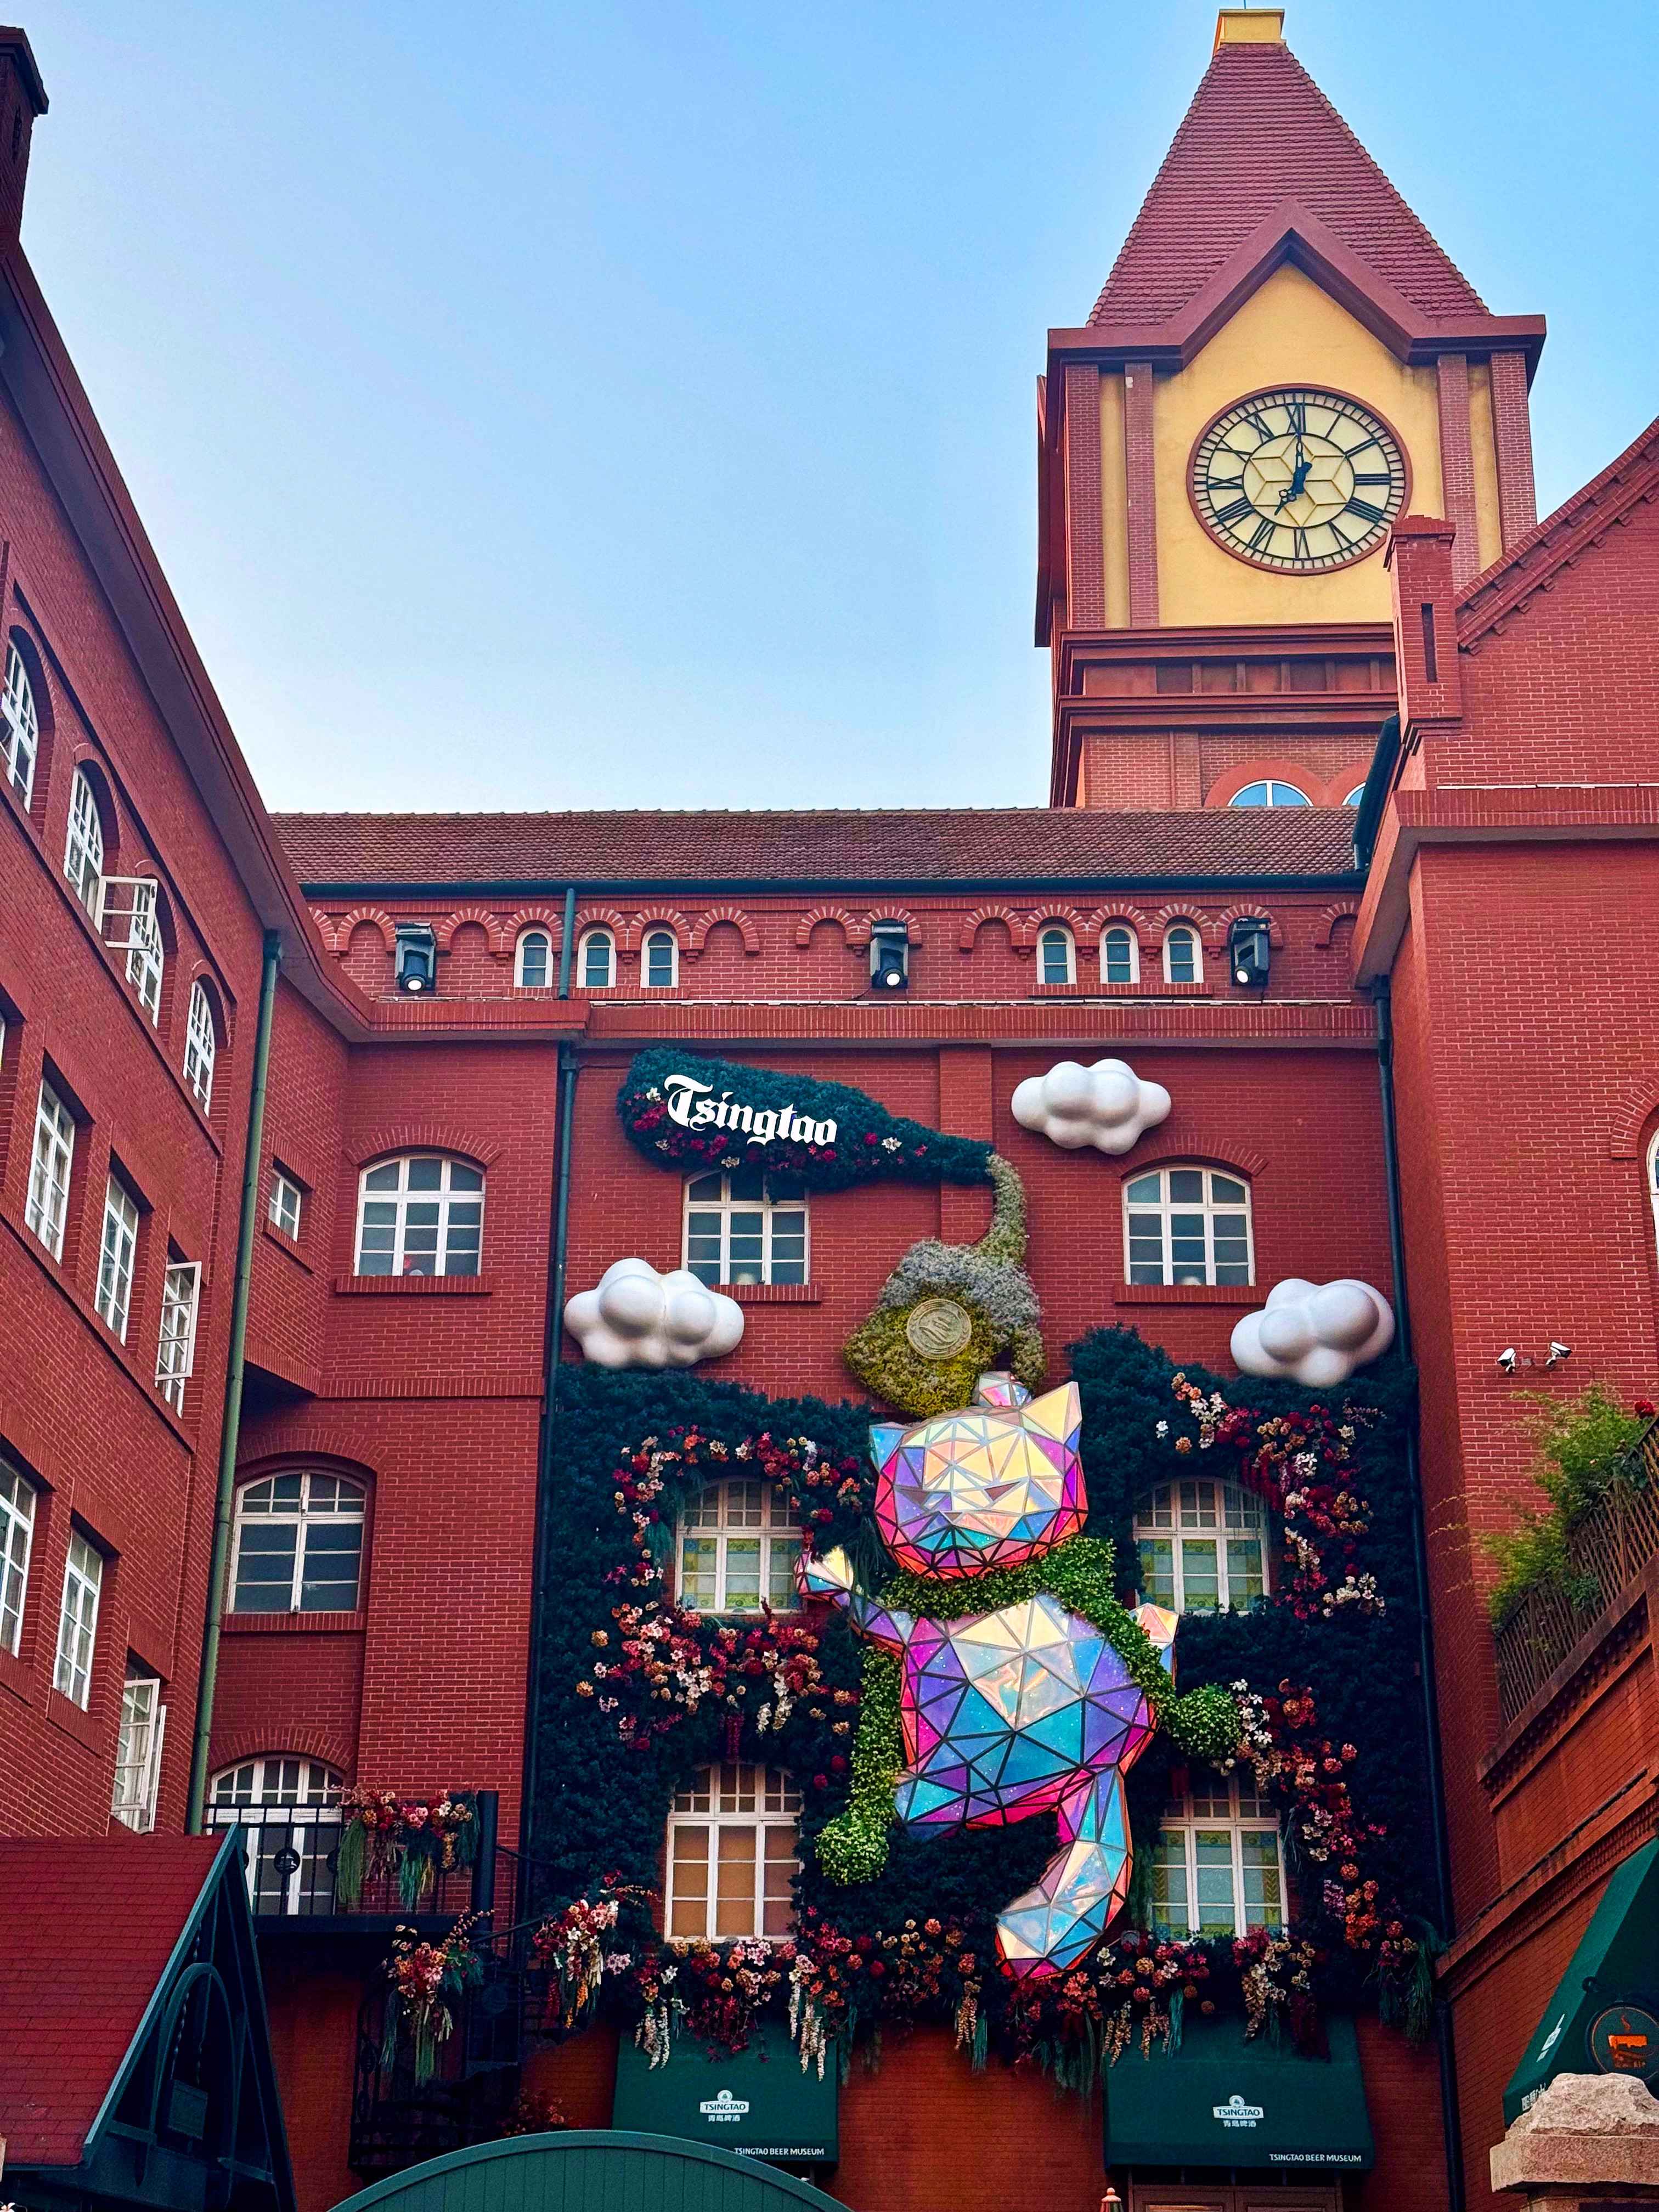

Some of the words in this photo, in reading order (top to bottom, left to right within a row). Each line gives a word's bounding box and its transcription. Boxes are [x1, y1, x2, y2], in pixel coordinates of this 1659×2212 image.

[1244, 413, 1275, 444] XI
[1284, 404, 1306, 433] XII
[1325, 411, 1342, 438] I
[1215, 439, 1253, 463] X
[1345, 438, 1379, 458] II
[1207, 475, 1243, 489] IX
[1355, 473, 1391, 486] III
[1215, 496, 1255, 531] VIII
[1248, 519, 1277, 552] VII
[1294, 528, 1311, 560] VI
[1327, 522, 1355, 550] V
[664, 1074, 838, 1146] Tsingtao
